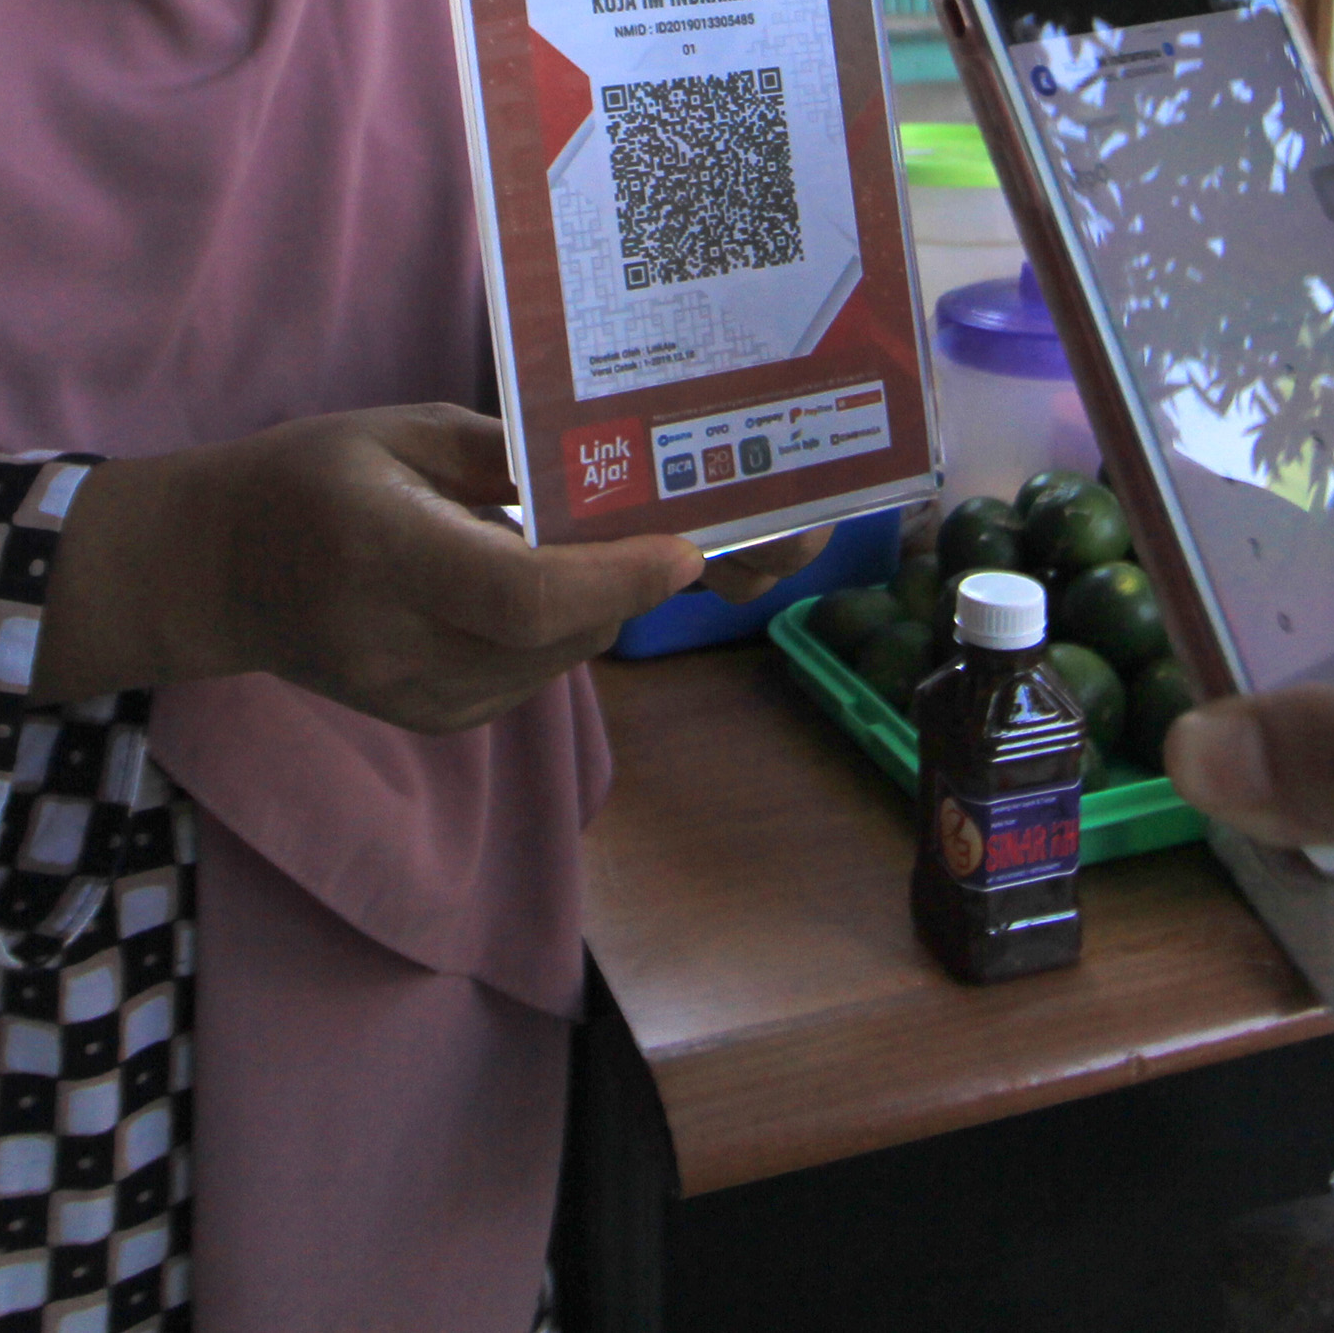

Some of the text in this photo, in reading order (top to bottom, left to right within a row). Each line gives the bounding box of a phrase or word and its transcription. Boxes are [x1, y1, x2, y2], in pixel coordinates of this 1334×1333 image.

[614, 22, 647, 38] NMID
[682, 43, 697, 55] 01
[706, 424, 729, 437] OVO
[580, 436, 632, 464] Link
[584, 459, 629, 490] Aja!
[667, 459, 693, 475] BCA
